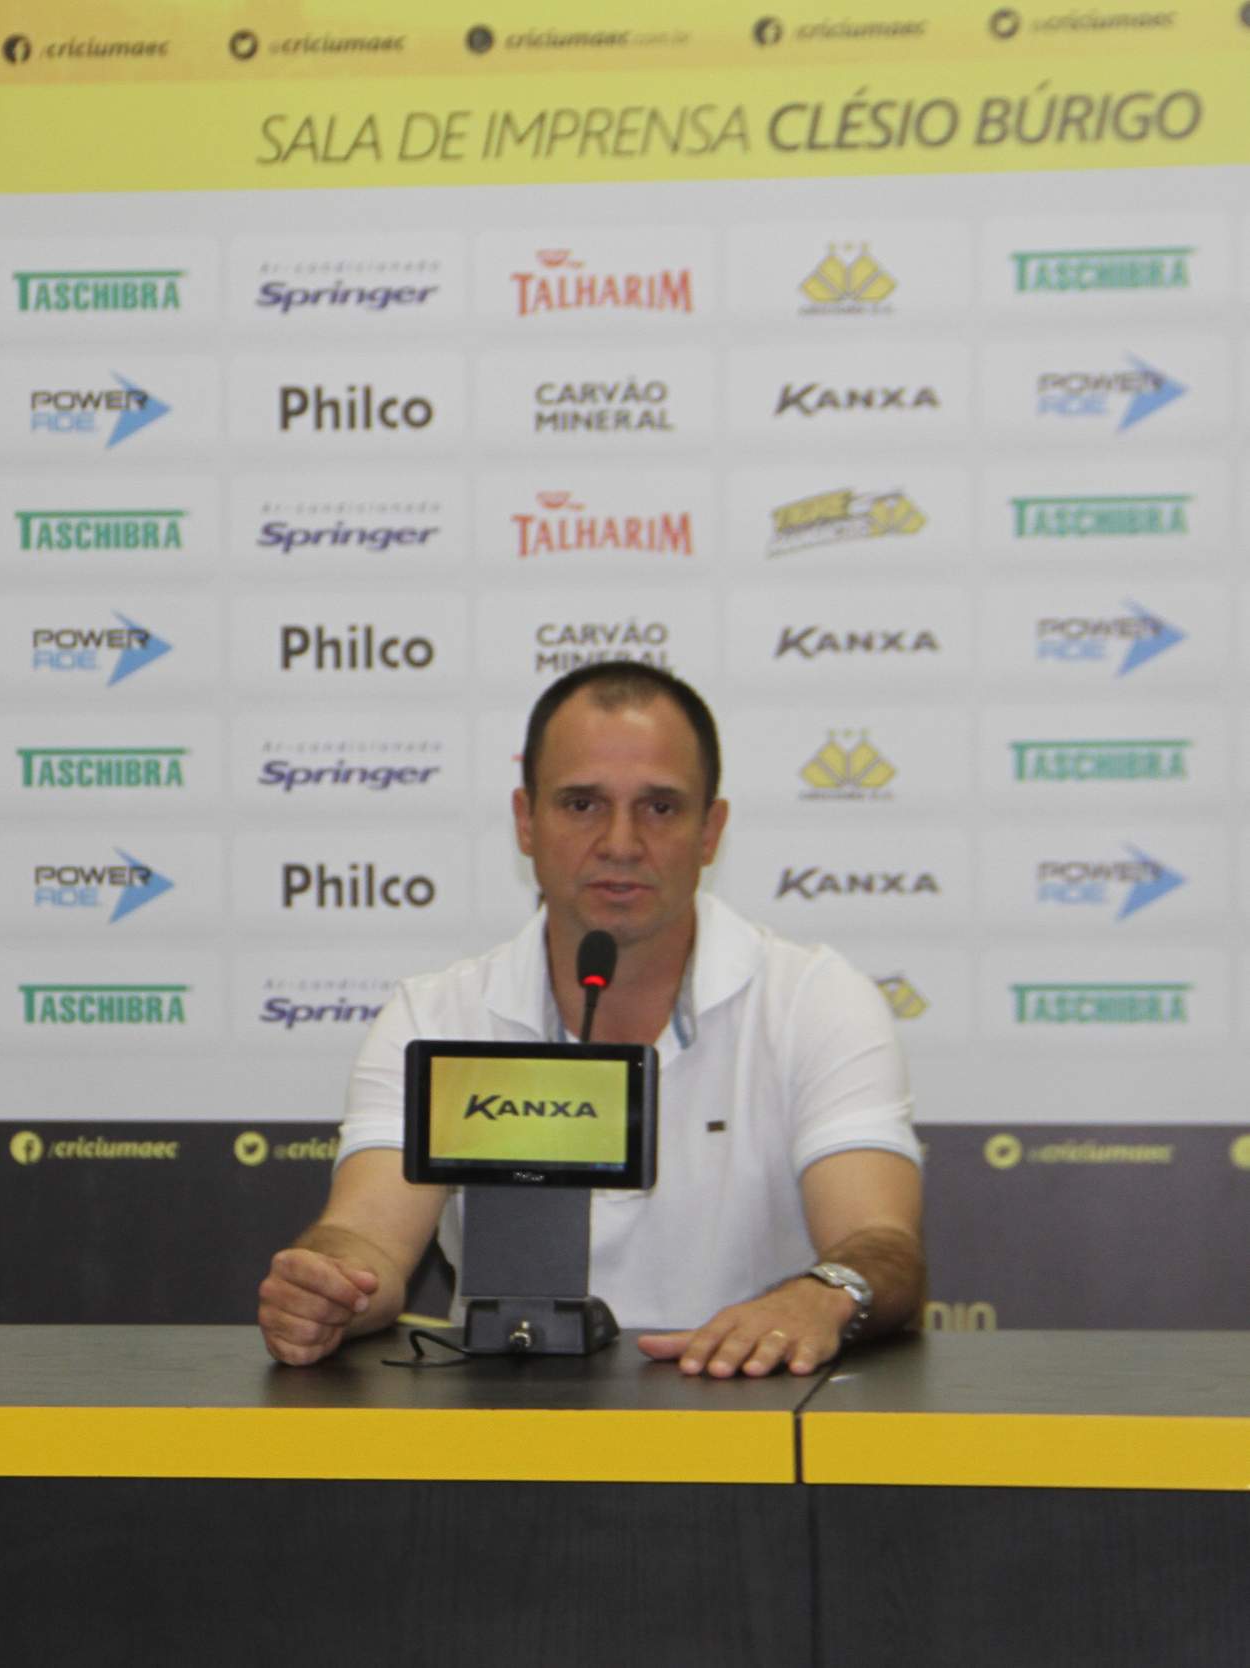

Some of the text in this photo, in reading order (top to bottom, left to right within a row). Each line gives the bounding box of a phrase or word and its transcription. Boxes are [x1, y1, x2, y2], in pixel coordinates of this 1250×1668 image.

[256, 81, 1205, 166] SALA DE IMPRENSA CLÉSIO BÚRIGO
[12, 269, 186, 312] TASCHIBRA
[257, 281, 436, 314] Springer
[511, 269, 693, 317] TALHARIM
[31, 388, 149, 411] POWER
[279, 385, 434, 432] Philco
[774, 383, 940, 417] KANXA
[534, 409, 673, 432] MINERAL
[14, 509, 188, 551] TASCHIBRA
[257, 521, 438, 554] Springer
[511, 512, 693, 558] TALHARIM
[33, 628, 151, 650] POWER
[281, 625, 435, 671] Philco
[774, 626, 940, 660] KANXA
[16, 747, 190, 789] TASCHIBRA
[259, 760, 439, 792] Springer
[34, 865, 153, 886] POWER
[282, 863, 436, 909] Philco
[775, 867, 940, 901] KANXA
[18, 984, 190, 1024] TASCHIBRA
[259, 997, 383, 1029] Sprin
[464, 1094, 597, 1120] KANXA
